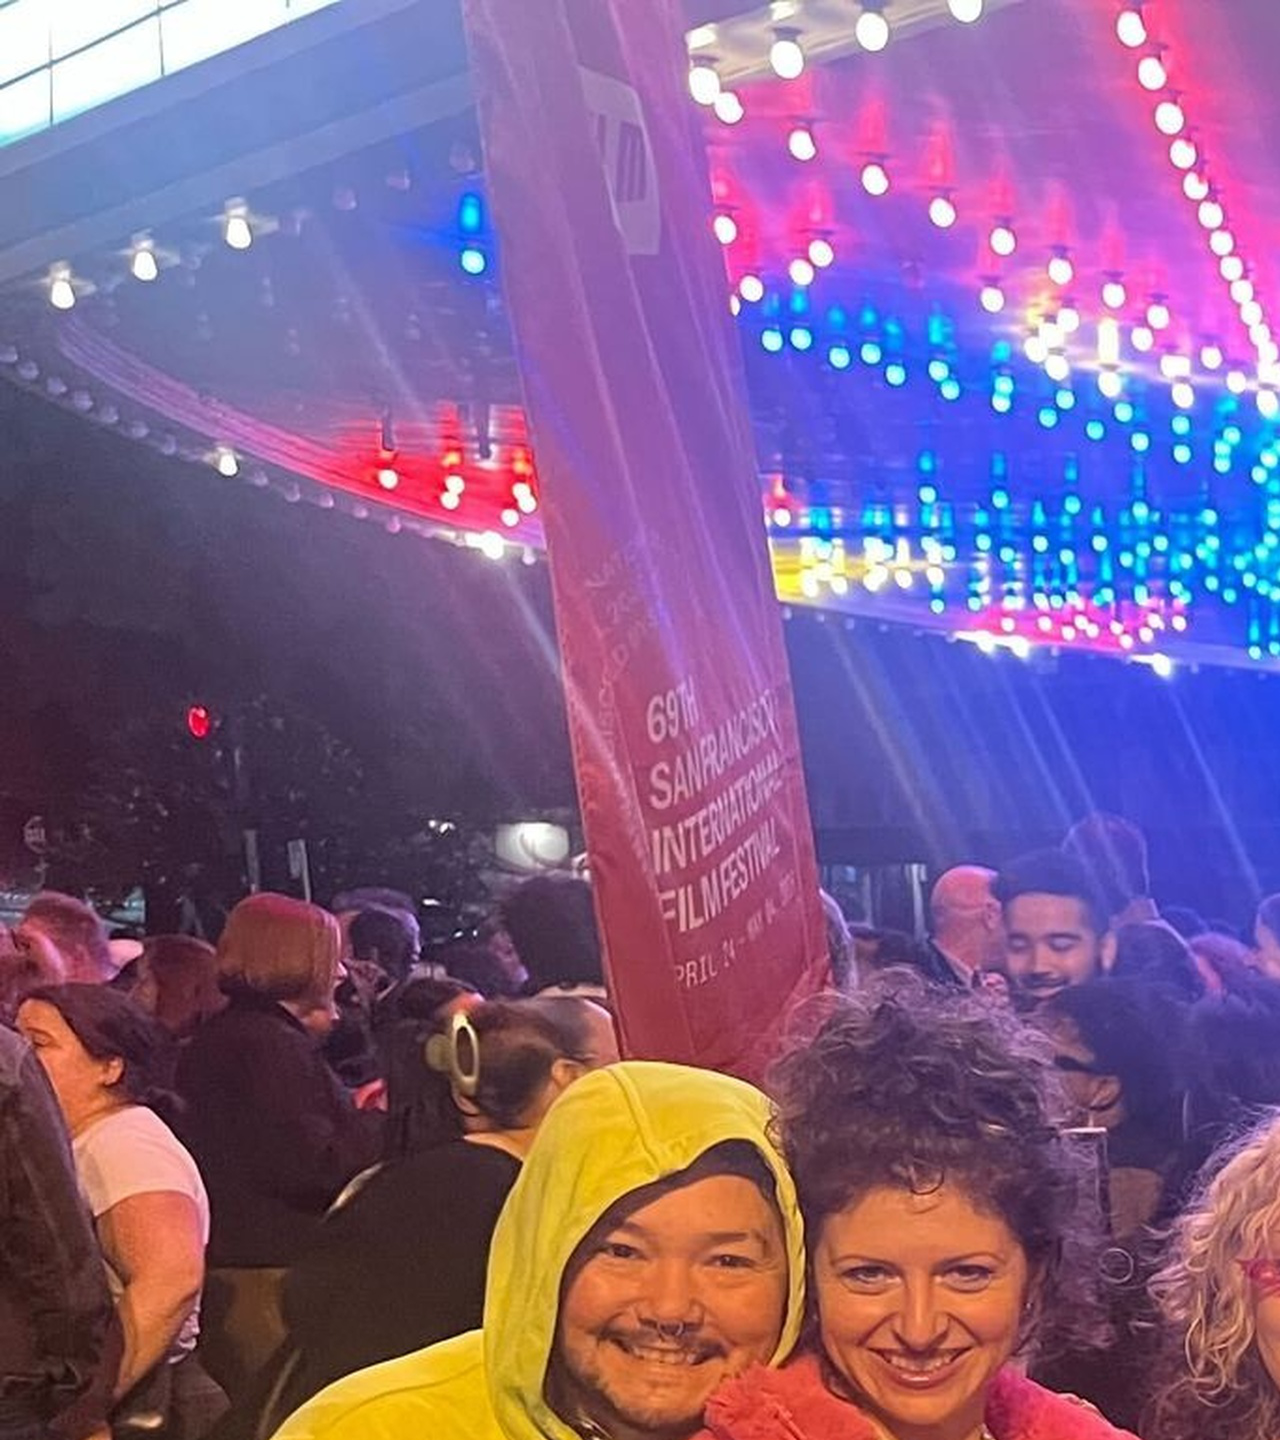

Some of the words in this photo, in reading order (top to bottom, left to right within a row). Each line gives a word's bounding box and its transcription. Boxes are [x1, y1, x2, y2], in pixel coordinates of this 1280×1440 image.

[646, 675, 700, 743] 69TH
[650, 743, 702, 810] SAN
[652, 748, 783, 875] INTERNATIONAL
[659, 868, 722, 933] FILM
[719, 816, 780, 908] FESTIVAL
